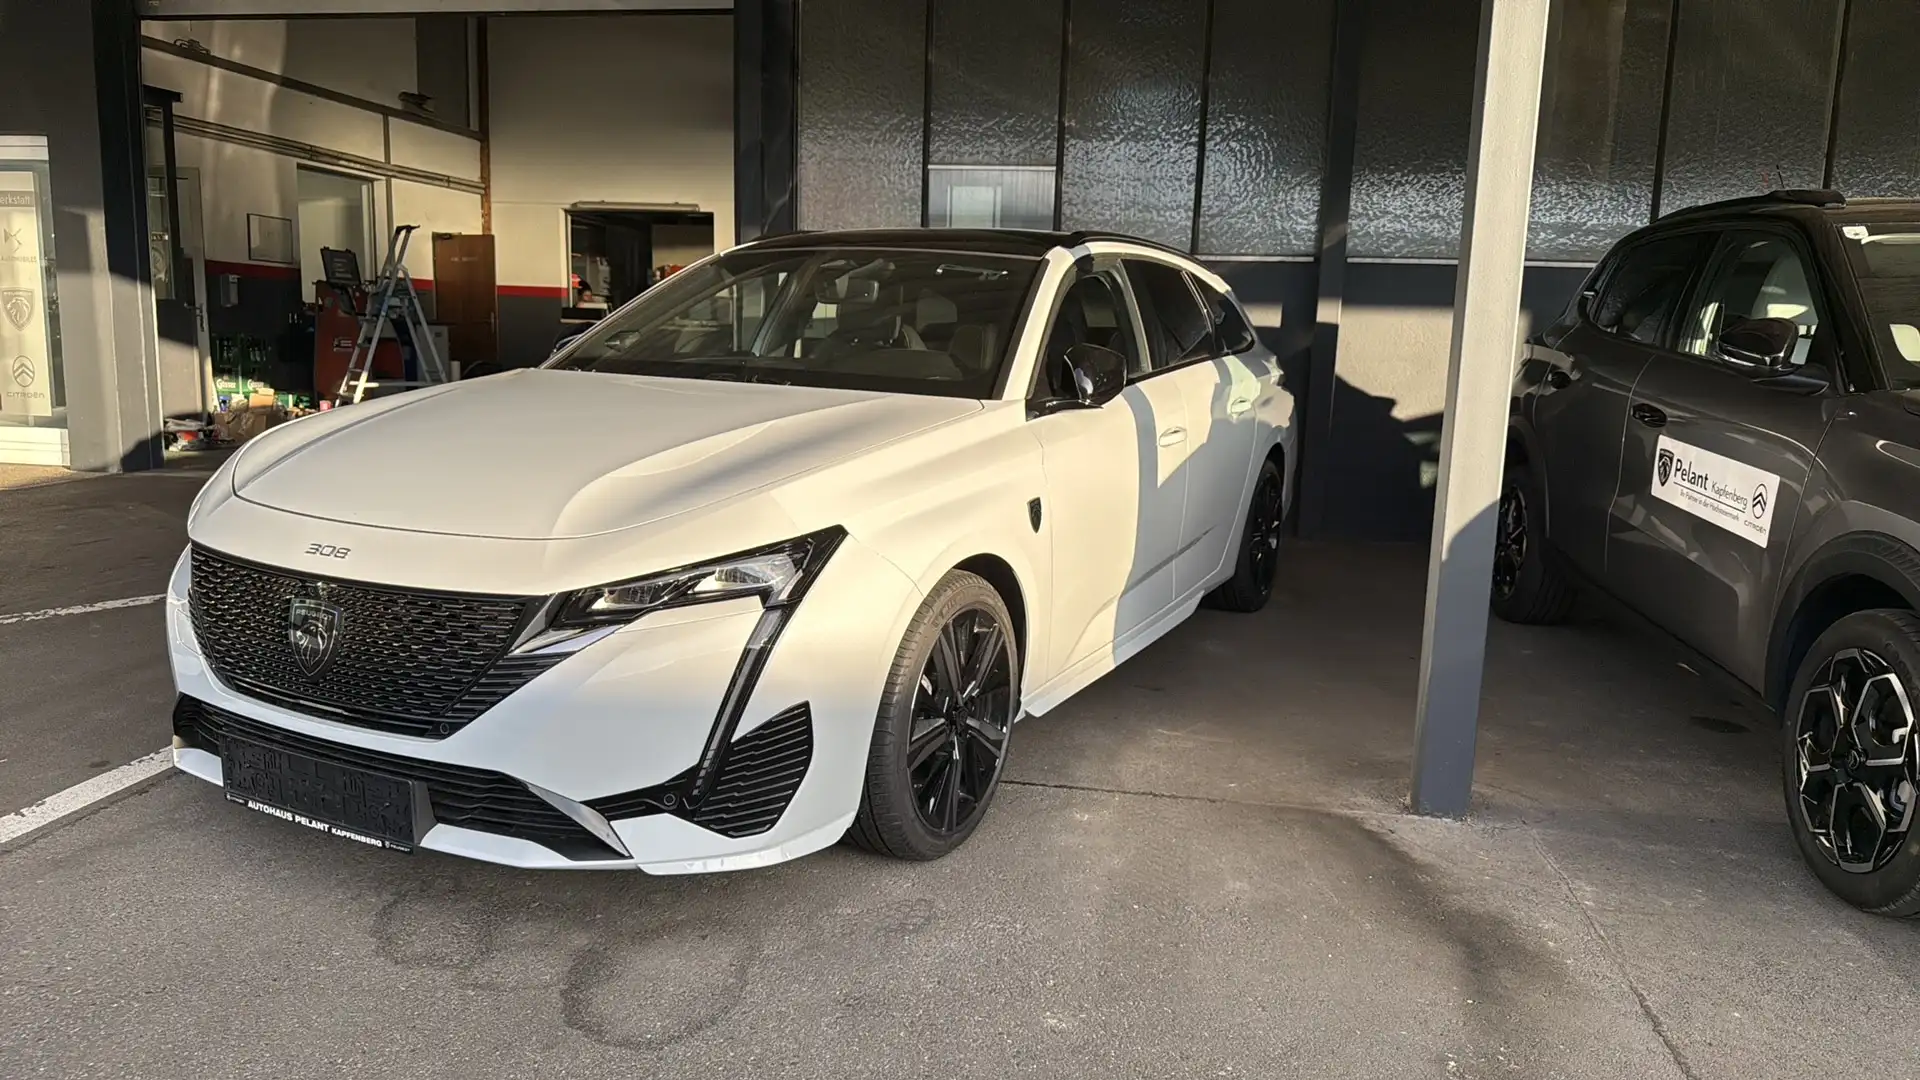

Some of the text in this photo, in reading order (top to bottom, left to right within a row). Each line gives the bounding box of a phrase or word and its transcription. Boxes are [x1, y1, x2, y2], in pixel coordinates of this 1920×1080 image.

[1674, 458, 1748, 511] Pelant Kapfenberg
[304, 543, 351, 559] 308
[295, 608, 333, 621] PEUGEOT
[247, 800, 293, 821] AUTOHAUS
[295, 815, 329, 833] PELANT
[331, 827, 383, 848] KAPFENBERG
